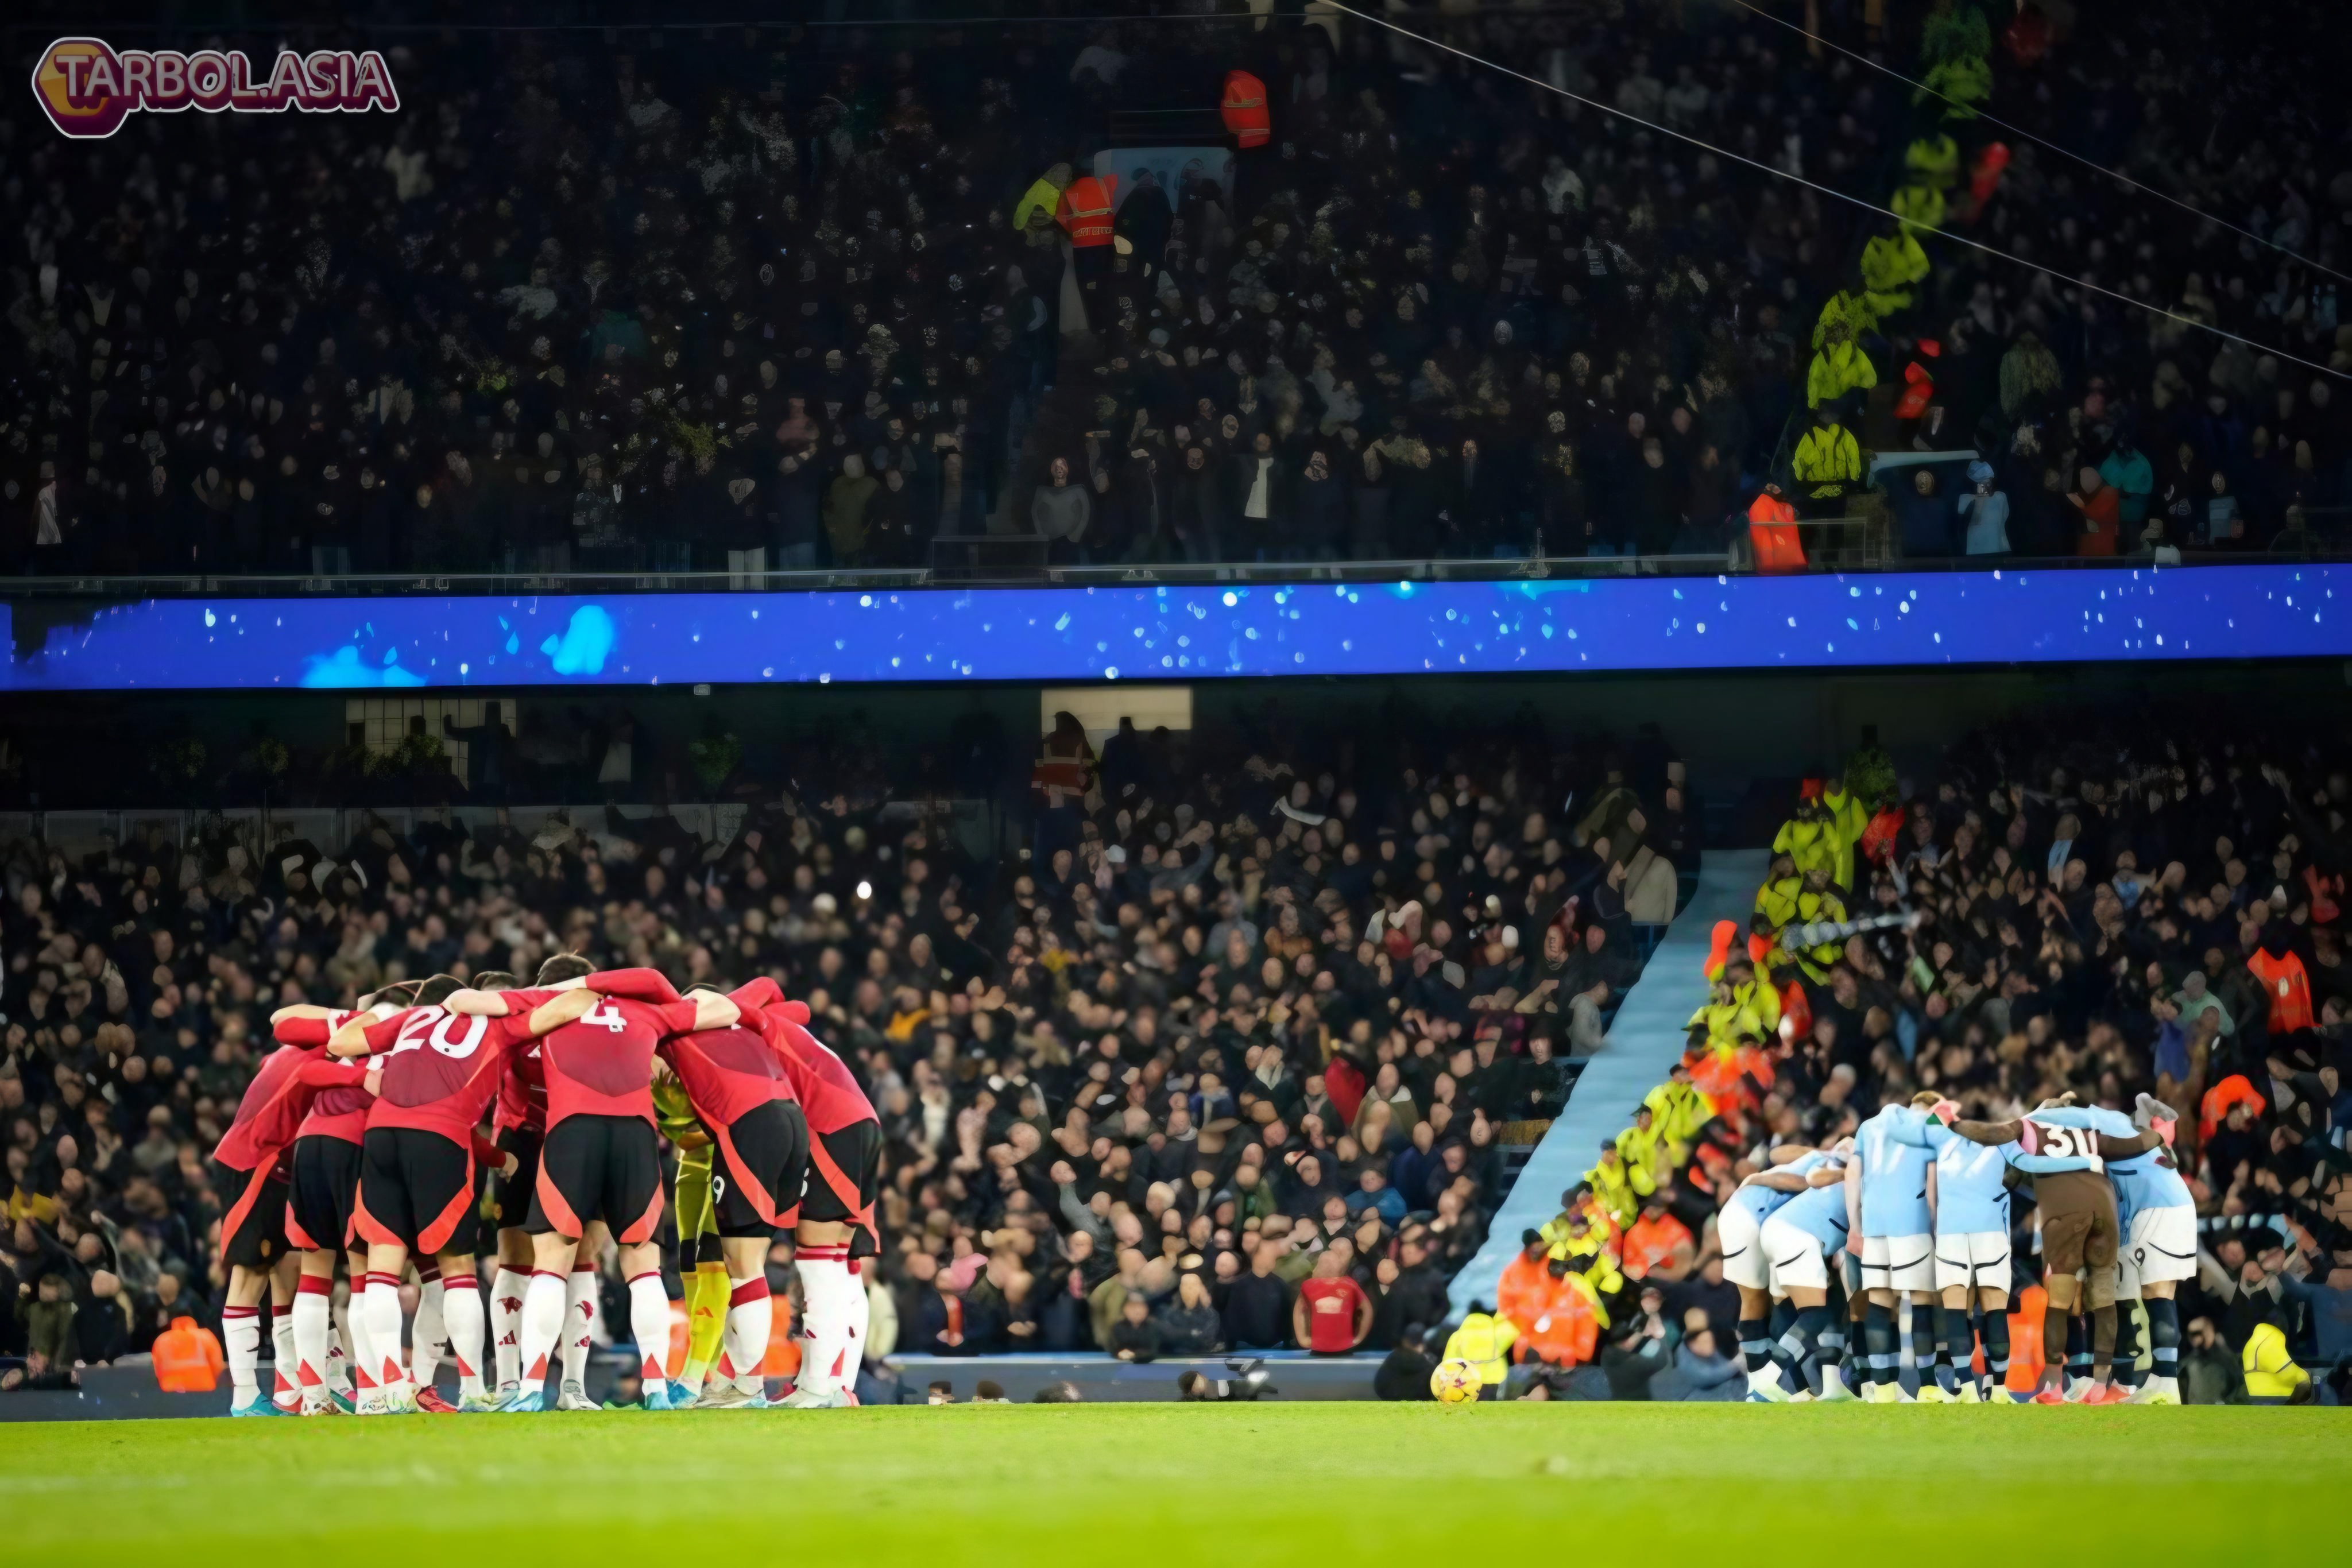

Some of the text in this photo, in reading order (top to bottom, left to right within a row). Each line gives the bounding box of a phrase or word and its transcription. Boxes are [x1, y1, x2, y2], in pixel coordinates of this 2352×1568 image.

[580, 996, 627, 1032] 4
[391, 1004, 489, 1059] 20
[712, 1175, 725, 1205] 9
[2134, 1247, 2146, 1267] 9
